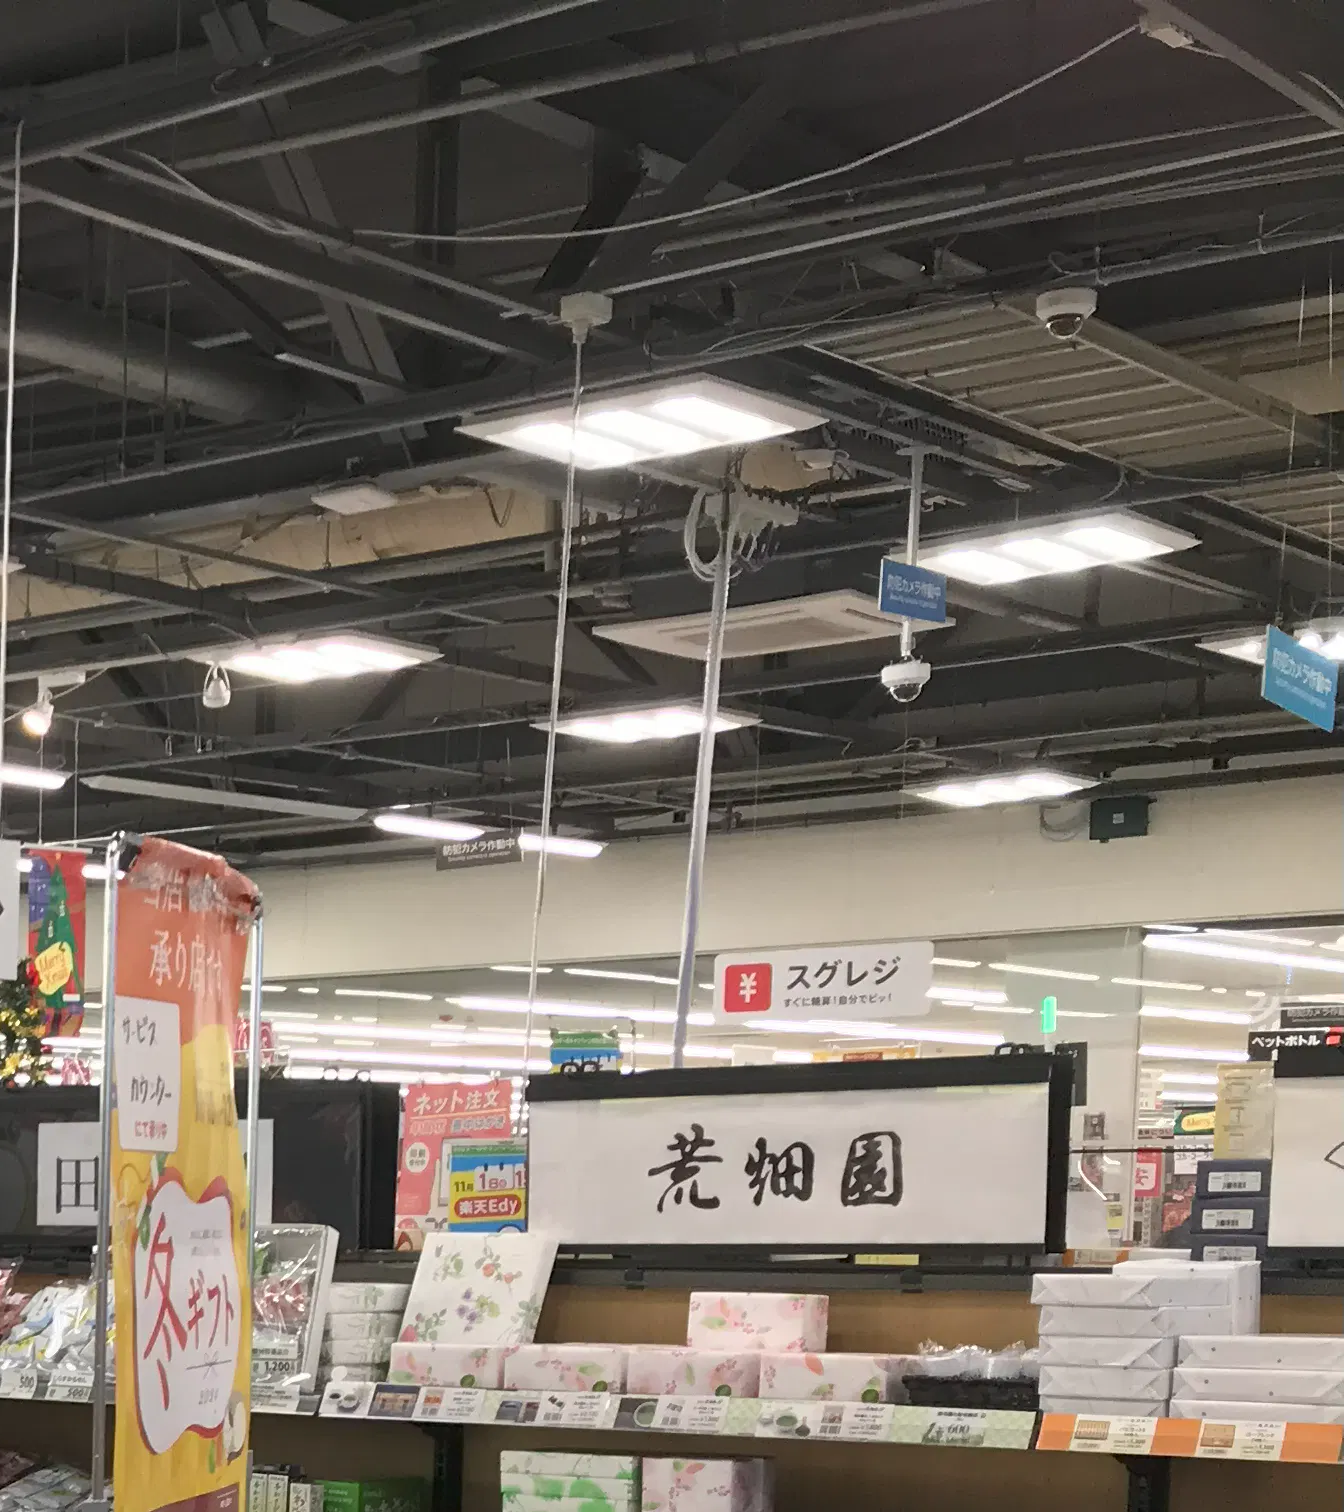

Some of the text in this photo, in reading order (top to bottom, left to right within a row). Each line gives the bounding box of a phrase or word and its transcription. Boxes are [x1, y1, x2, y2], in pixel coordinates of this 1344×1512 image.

[787, 956, 901, 990] スグレジ
[1252, 1034, 1320, 1048] ペットボトル
[413, 1089, 500, 1115] ネット注文
[648, 1123, 904, 1213] 荒畑園
[459, 1198, 518, 1216] 楽天Edy
[144, 1211, 188, 1411] 冬
[188, 1268, 234, 1350] ギフト
